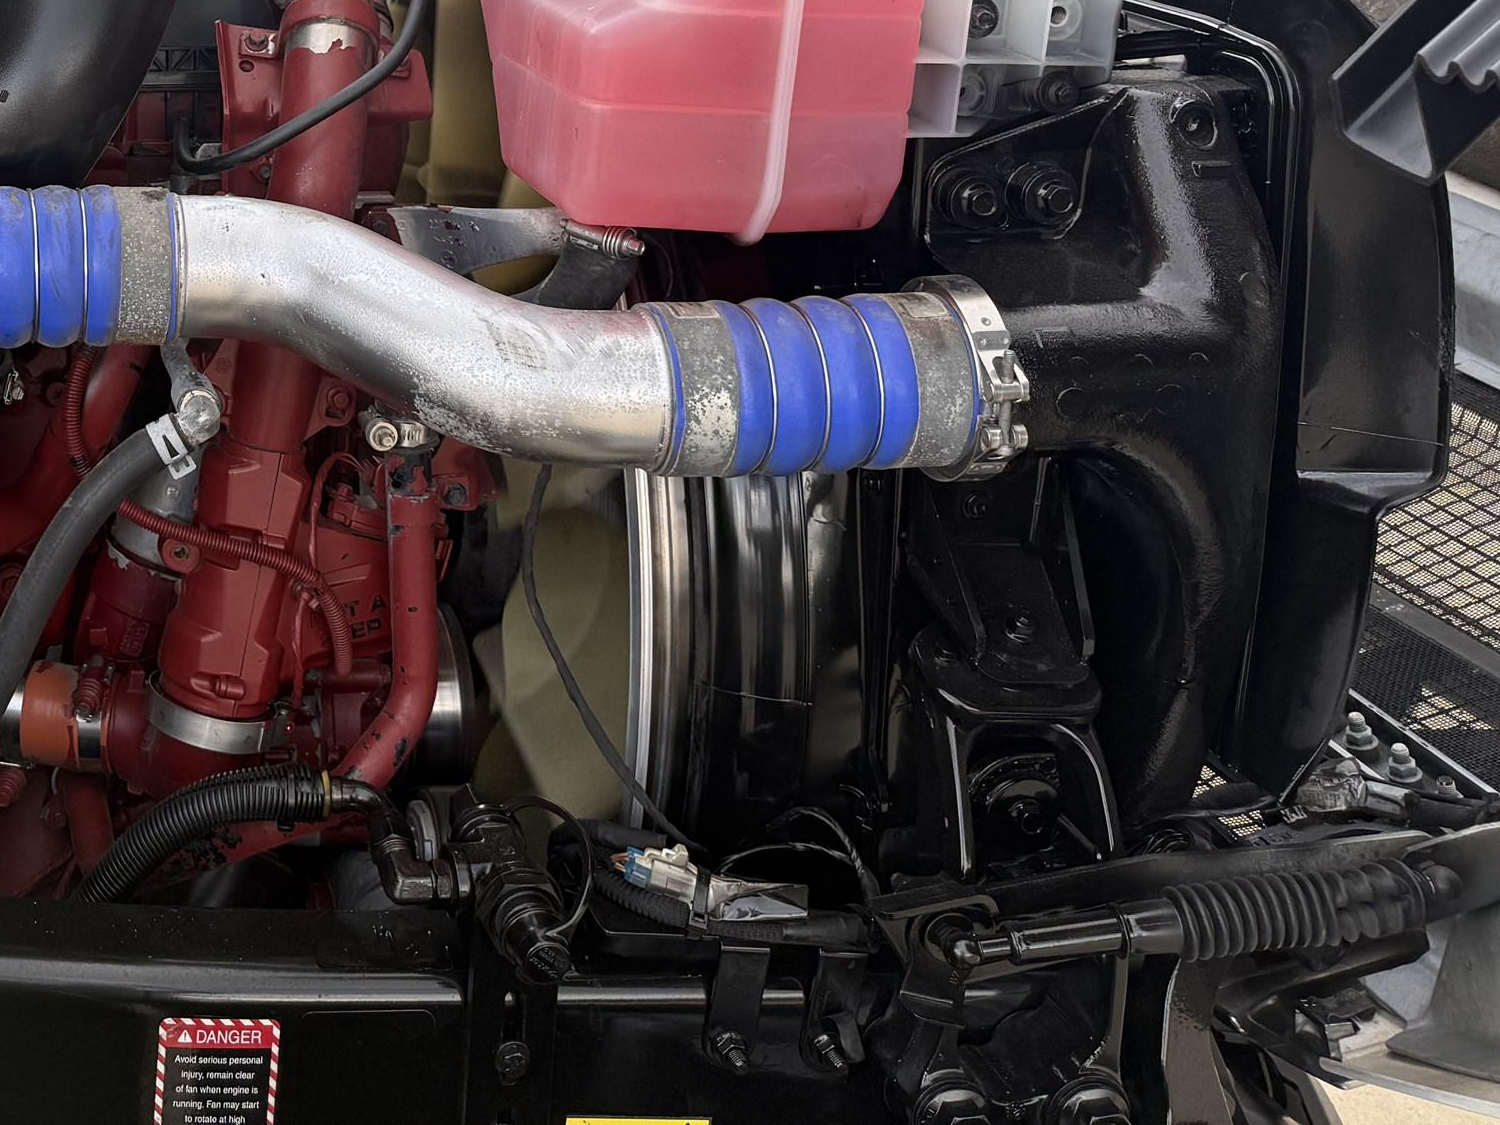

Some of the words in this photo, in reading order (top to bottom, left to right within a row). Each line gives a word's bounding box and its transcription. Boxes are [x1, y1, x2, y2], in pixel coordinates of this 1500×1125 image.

[196, 1030, 262, 1044] DANGER
[174, 1055, 197, 1064] Avoid
[198, 1055, 227, 1065] serious
[229, 1056, 263, 1066] personal
[206, 1071, 234, 1080] remain
[235, 1071, 255, 1080] clear
[175, 1084, 184, 1093] of
[185, 1085, 198, 1093] fan
[200, 1085, 220, 1094] when
[223, 1086, 250, 1096] engine
[251, 1086, 259, 1094] is
[172, 1099, 204, 1110] running.
[206, 1100, 221, 1109] Fan
[223, 1102, 240, 1111] may
[241, 1101, 260, 1109] start
[184, 1115, 193, 1123] to
[194, 1115, 217, 1124] rotate
[219, 1115, 227, 1123] at
[228, 1115, 246, 1125] high
